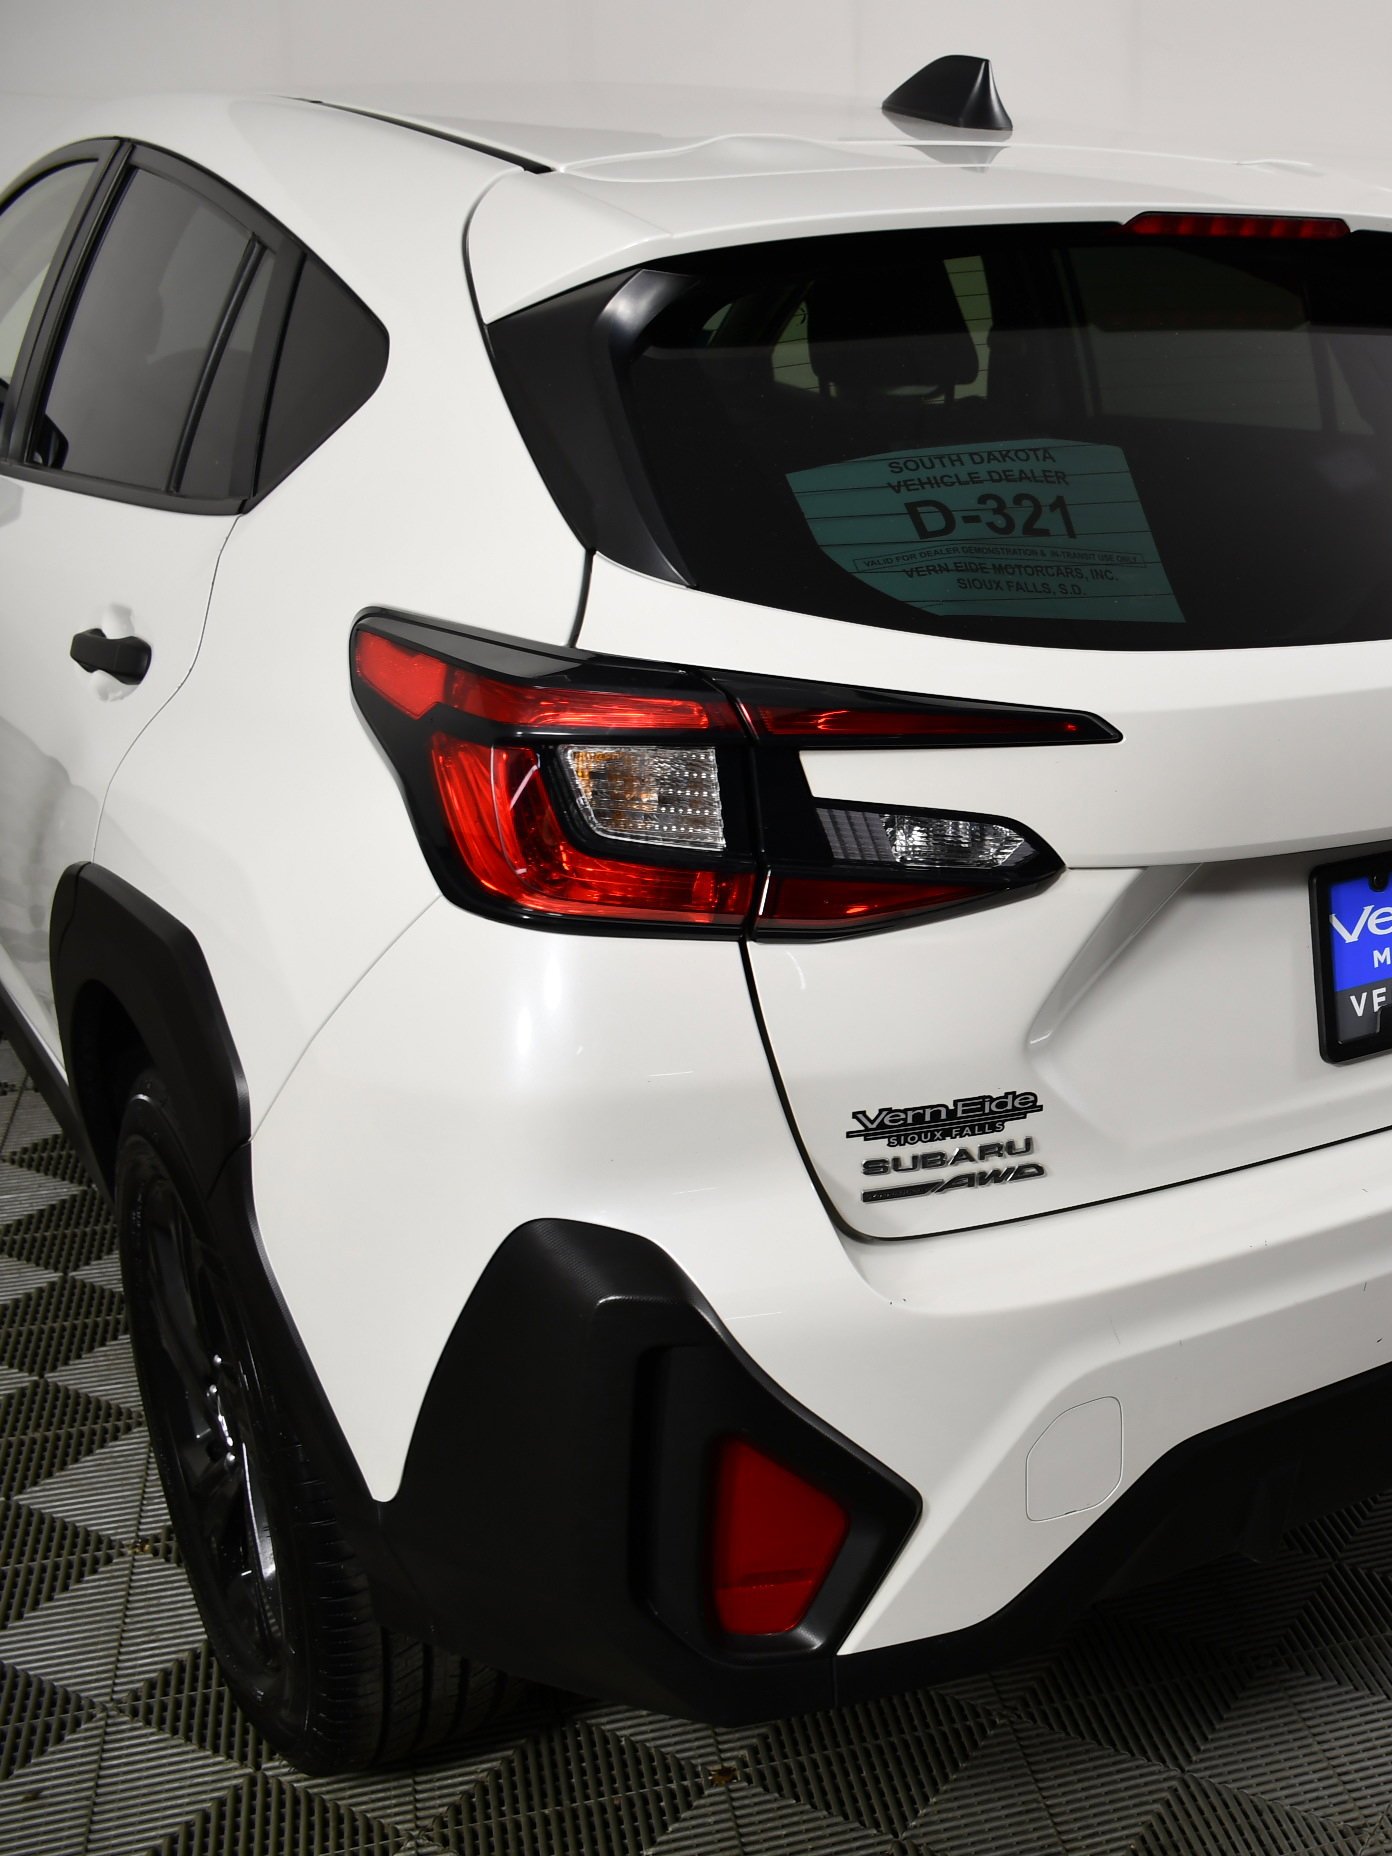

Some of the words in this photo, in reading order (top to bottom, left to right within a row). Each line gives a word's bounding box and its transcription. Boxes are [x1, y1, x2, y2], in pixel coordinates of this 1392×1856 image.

[888, 454, 965, 474] SOUTH
[969, 448, 1056, 465] DAKOTA
[887, 472, 984, 494] VEHICLE
[988, 469, 1069, 486] DEALER
[904, 493, 1077, 540] D-321
[863, 557, 894, 568] VALID
[895, 553, 917, 563] FOR
[918, 547, 960, 559] DEALER
[903, 563, 949, 578] VERN
[953, 560, 989, 574] EIDE
[992, 562, 1088, 582] MOTORCARS,
[1090, 568, 1119, 582] INC.
[957, 577, 1003, 591] SIOUX
[1005, 579, 1056, 595] FALLS,
[1059, 584, 1087, 596] S.D.
[855, 1105, 947, 1130] Vern
[956, 1091, 1037, 1117] Eide
[889, 1131, 943, 1146] SIOUX
[952, 1121, 1005, 1137] FALLS
[862, 1136, 1034, 1175] SUBARU
[932, 1163, 1045, 1193] AWD
